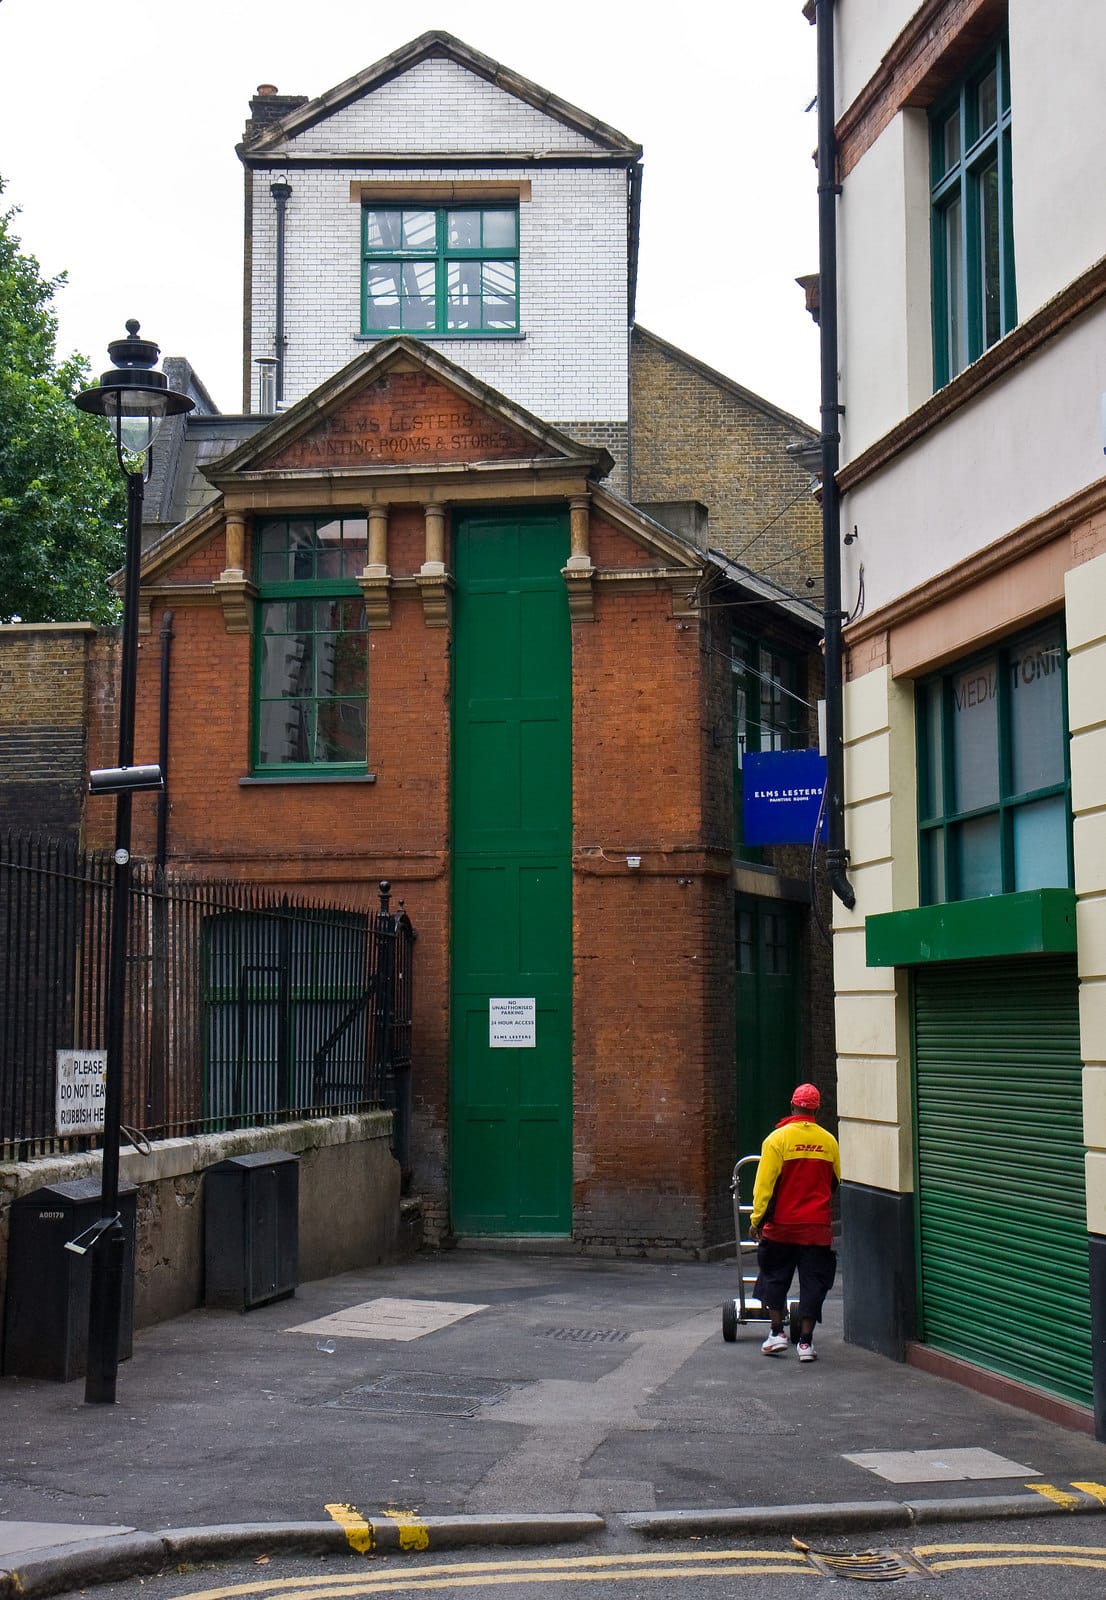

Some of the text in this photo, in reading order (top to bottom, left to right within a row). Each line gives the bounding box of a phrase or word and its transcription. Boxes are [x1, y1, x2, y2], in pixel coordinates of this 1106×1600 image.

[330, 413, 473, 433] ELMS LESTERS
[300, 432, 510, 457] PAINTING ROOMS & STORES
[754, 788, 823, 798] ELMS LESTERS
[73, 1060, 103, 1074] PLEASE
[60, 1083, 106, 1099] DO NOT LEA
[94, 1107, 104, 1122] HE
[795, 1143, 824, 1152] DHL
